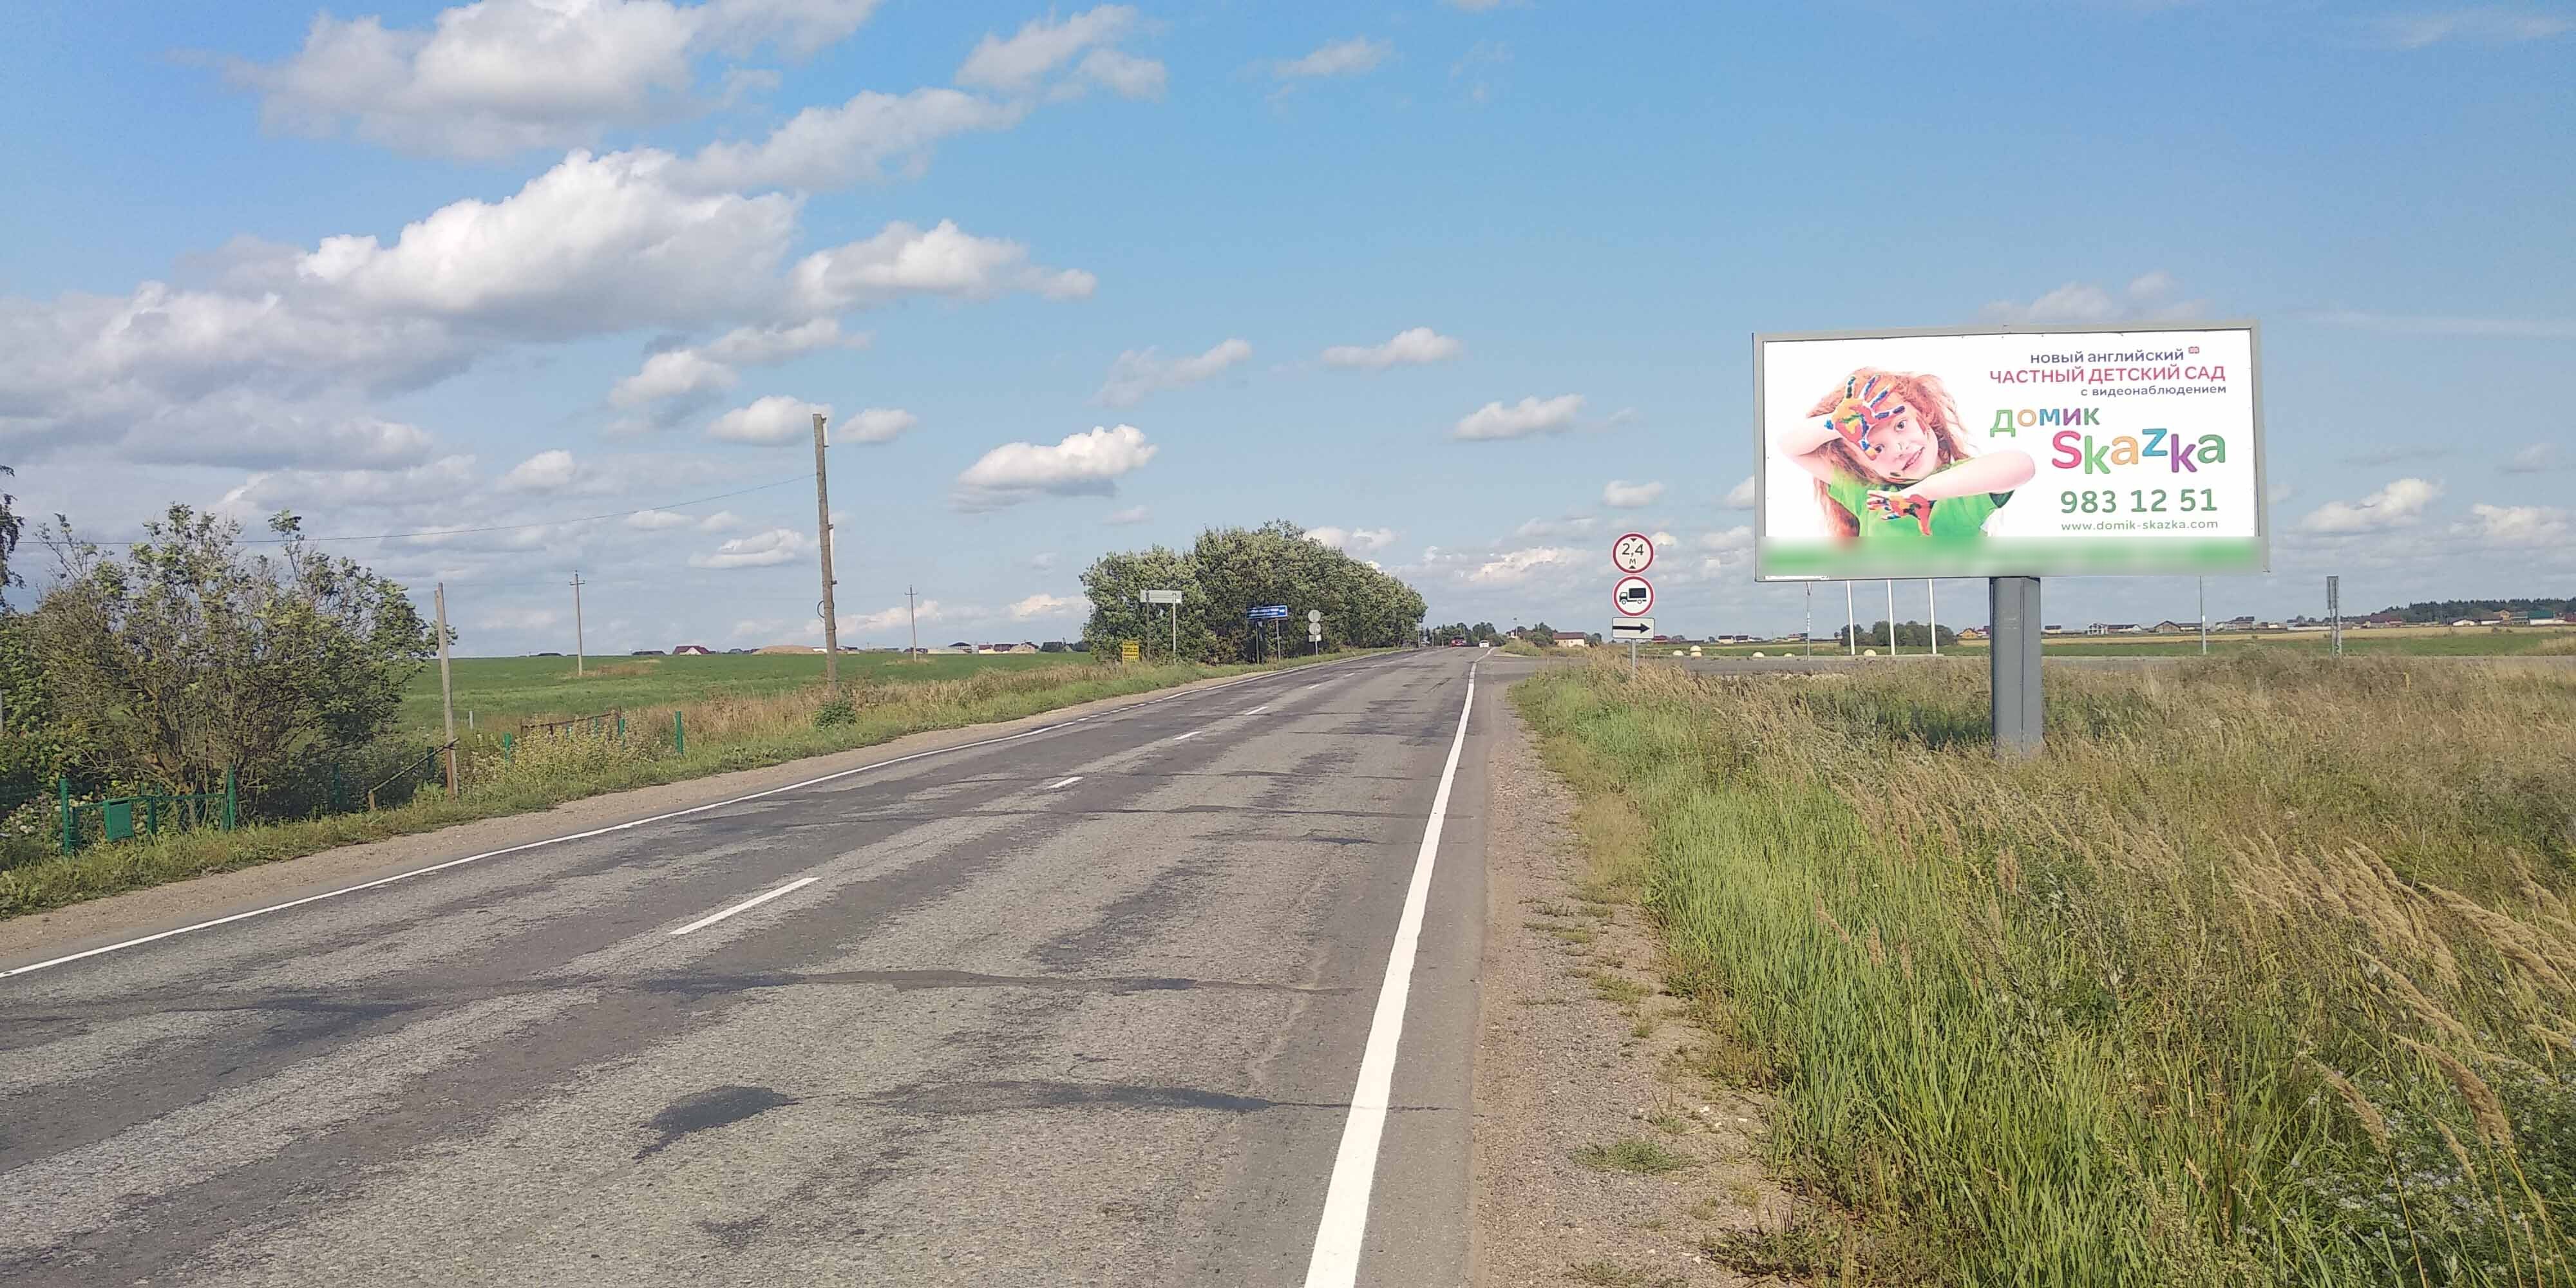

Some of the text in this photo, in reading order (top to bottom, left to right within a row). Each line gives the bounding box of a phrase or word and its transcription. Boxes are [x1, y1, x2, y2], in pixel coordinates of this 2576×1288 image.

[2031, 349, 2184, 364] новый английский
[1990, 364, 2226, 384] ЧАСТНЫЙ ДЕТСКИЙ САД
[2092, 384, 2226, 397] видеонаблюдением
[2052, 428, 2226, 474] Skazka
[2061, 488, 2217, 513] 983 12 51
[2061, 520, 2218, 531] www.domik-skazka.com
[1622, 543, 1644, 556] 2,4
